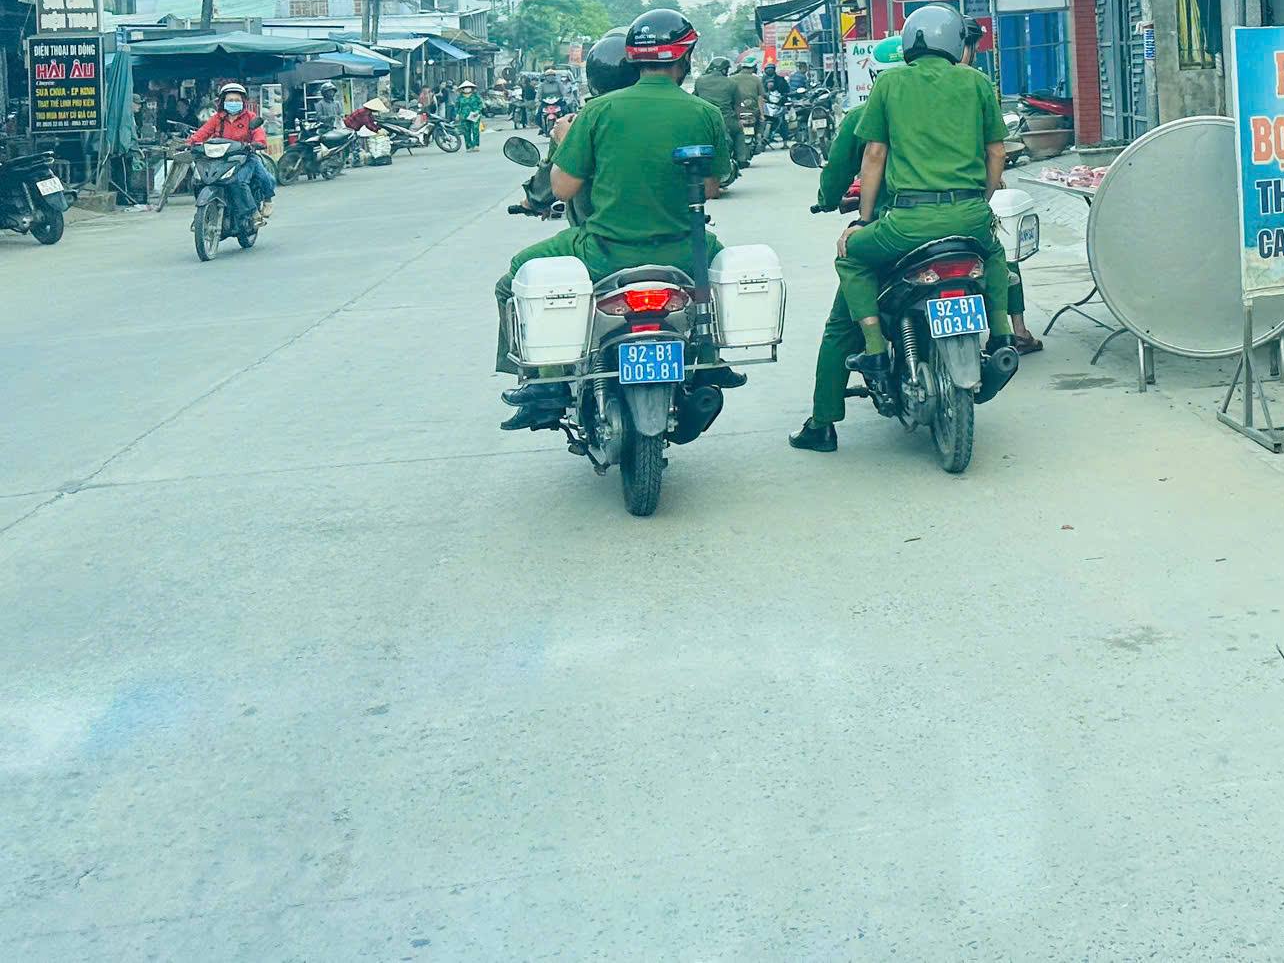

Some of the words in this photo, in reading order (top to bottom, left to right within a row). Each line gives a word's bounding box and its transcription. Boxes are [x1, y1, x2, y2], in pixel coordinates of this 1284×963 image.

[36, 59, 65, 79] HẢI
[70, 59, 95, 78] ÂU
[935, 298, 977, 317] 92-B1
[932, 313, 985, 335] 003.41
[628, 345, 672, 362] 92-B1
[623, 363, 679, 382] 005.81
